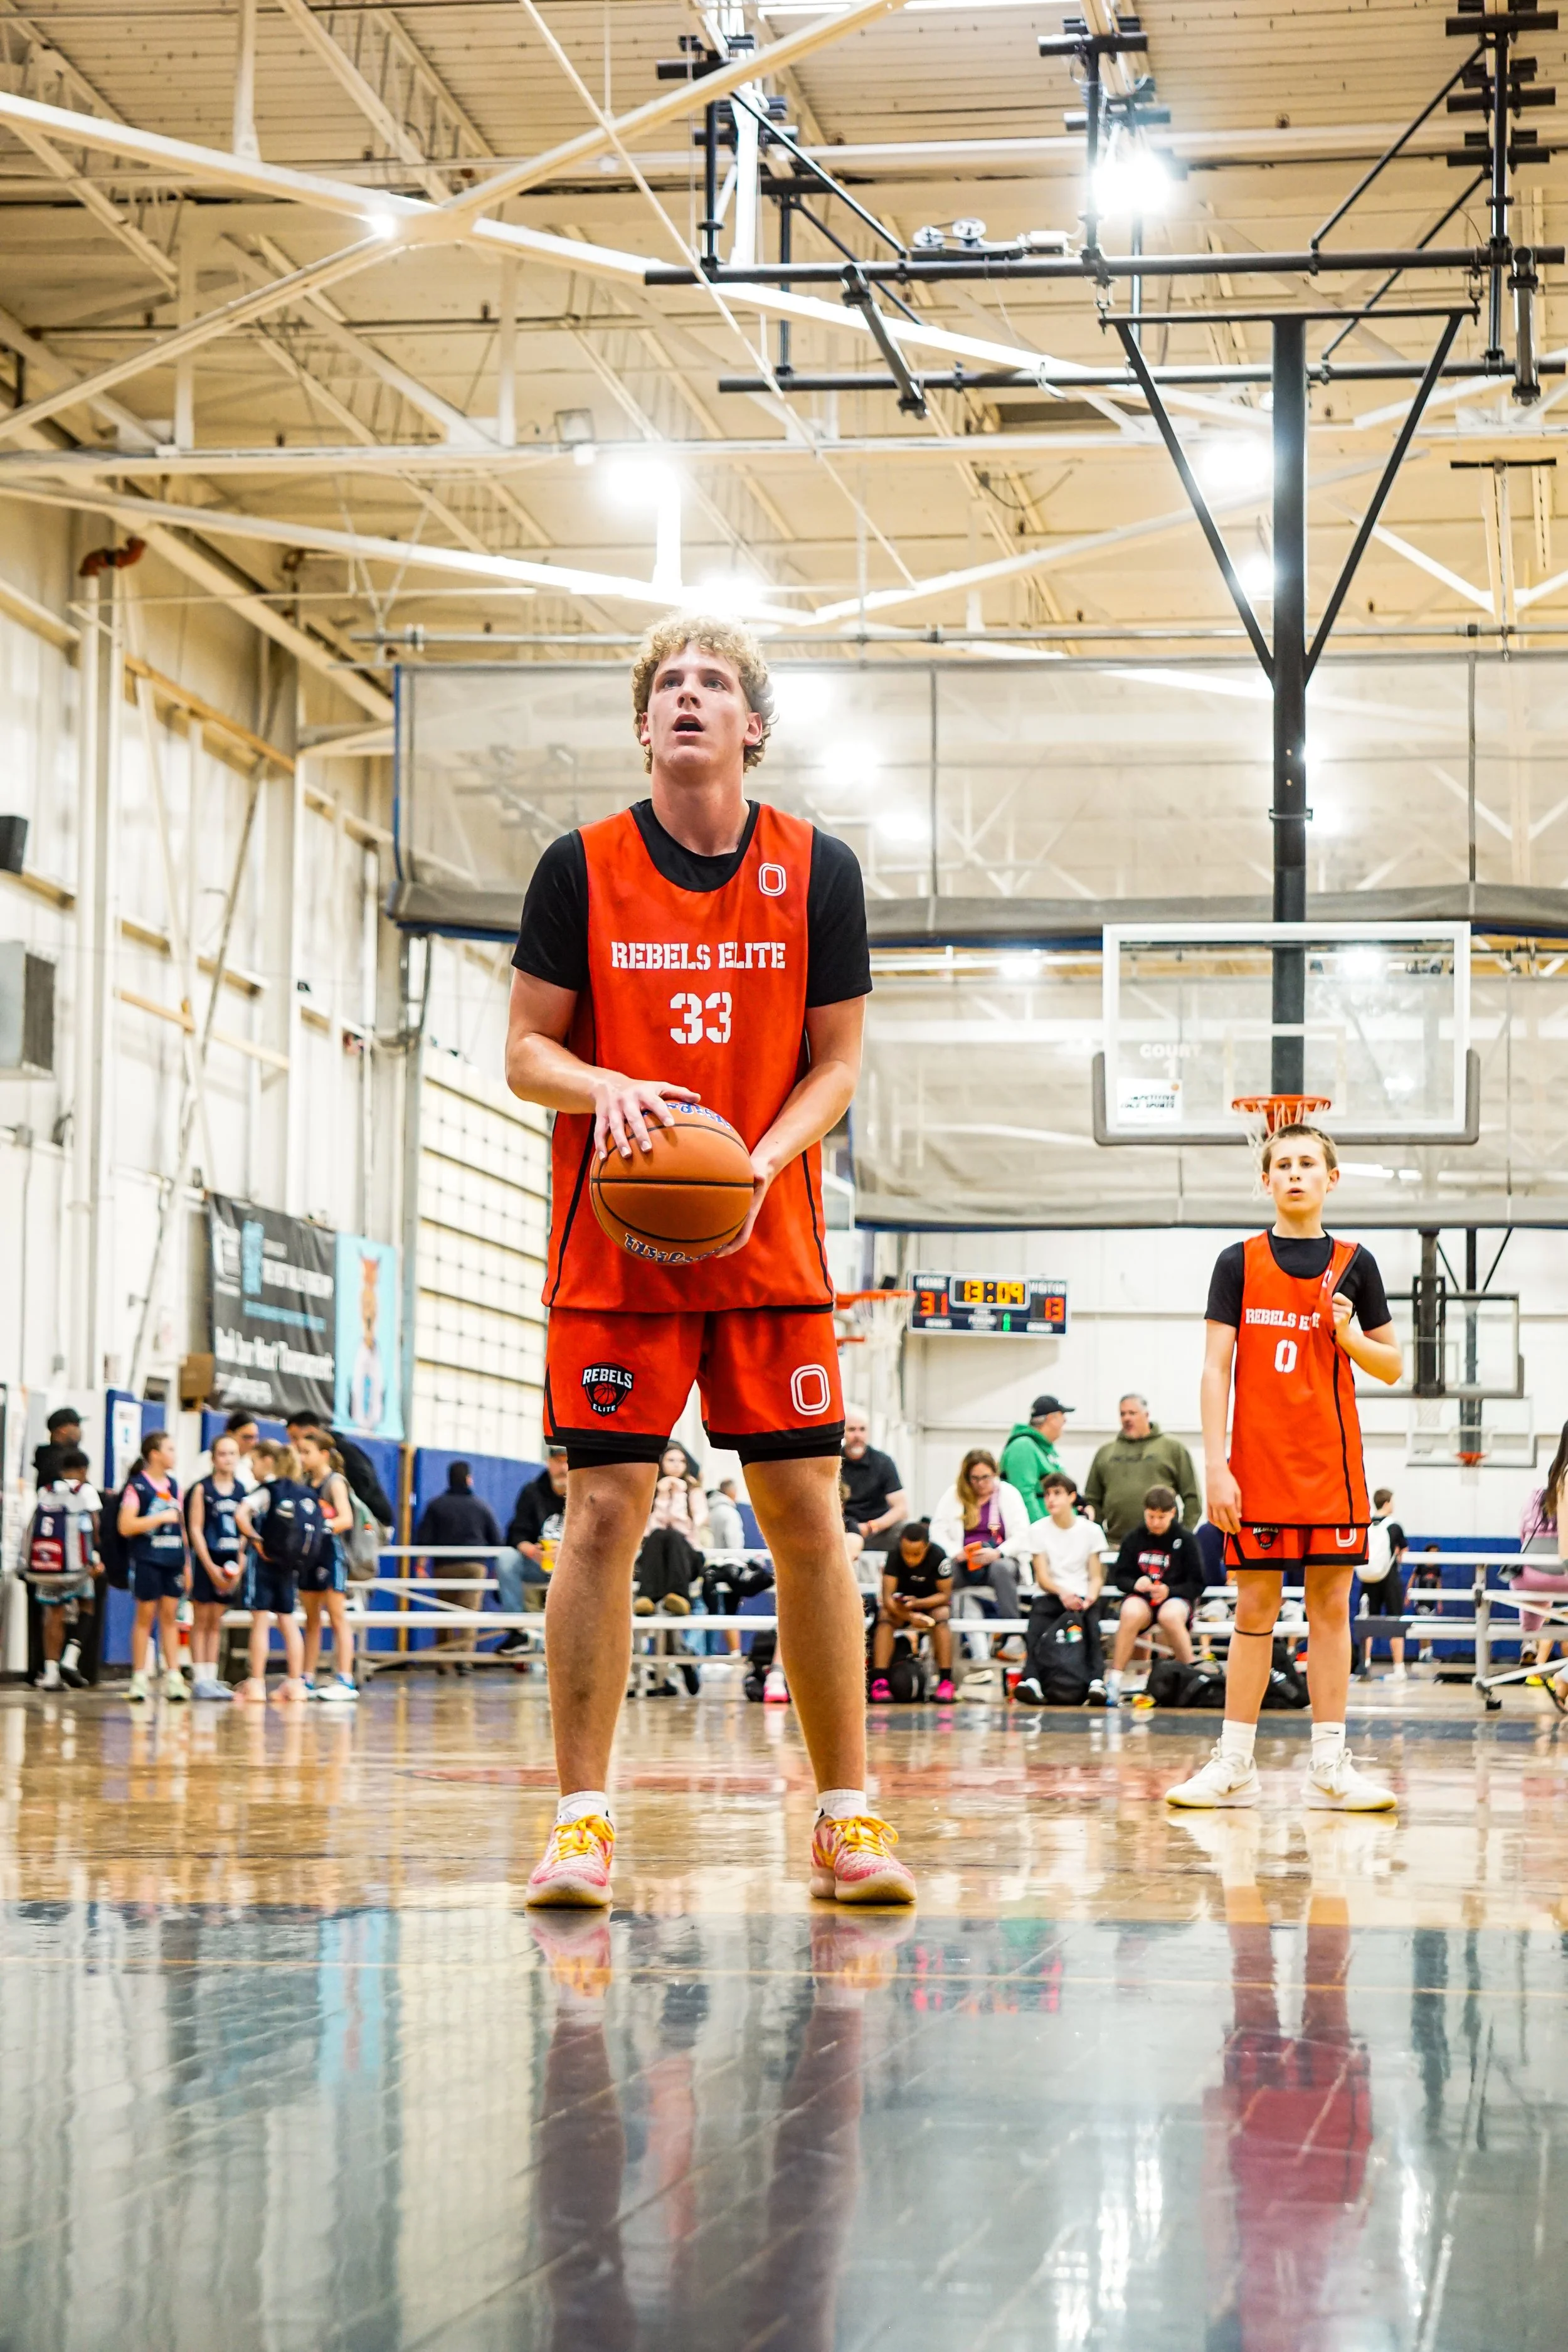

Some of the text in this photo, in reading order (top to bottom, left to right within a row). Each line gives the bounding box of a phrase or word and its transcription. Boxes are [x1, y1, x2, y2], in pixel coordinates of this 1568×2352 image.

[611, 941, 786, 970] REBELS ELITE
[670, 992, 733, 1044] 33
[919, 1291, 948, 1317] 31
[964, 1279, 1024, 1305] 13:09
[1045, 1297, 1065, 1322] 13
[1245, 1308, 1297, 1328] REBELS
[1274, 1339, 1298, 1374] 0
[582, 1368, 633, 1389] REBELS
[593, 1403, 616, 1412] ELITE
